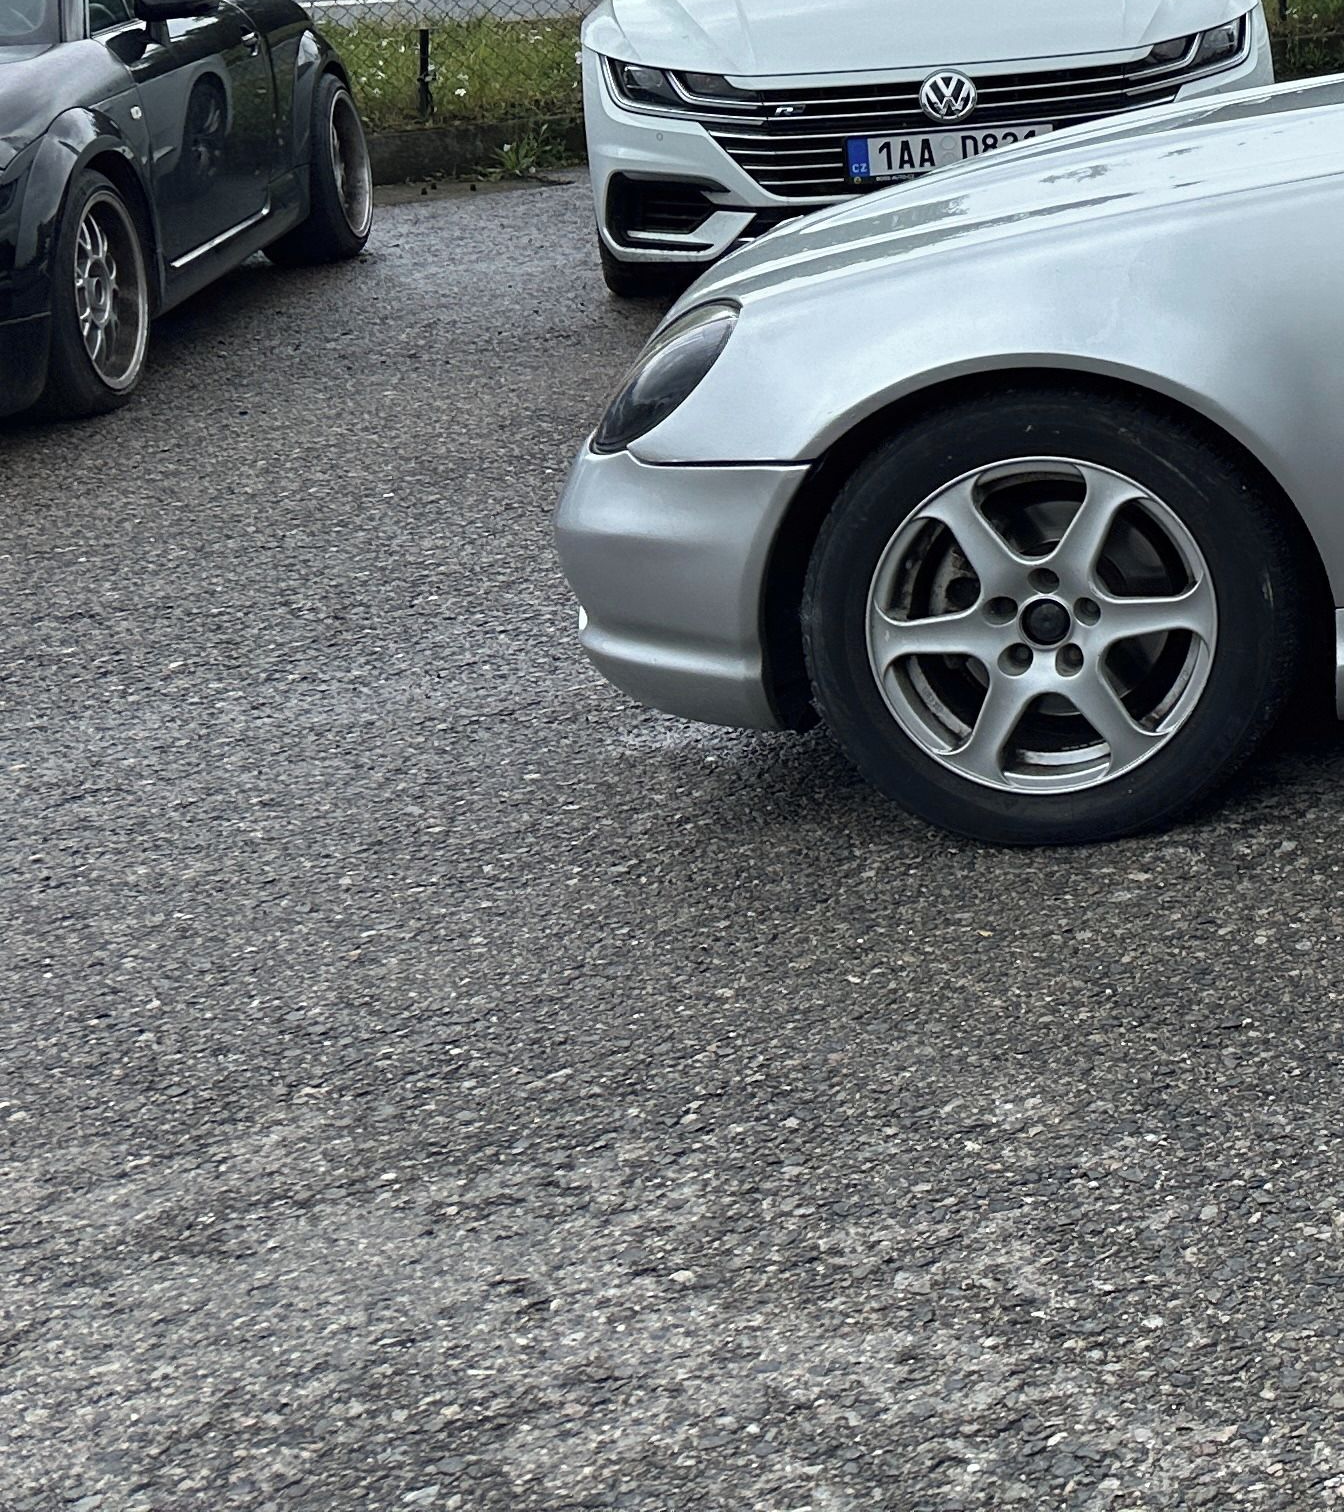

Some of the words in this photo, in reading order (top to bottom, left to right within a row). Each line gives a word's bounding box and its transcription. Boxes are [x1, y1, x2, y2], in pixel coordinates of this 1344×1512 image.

[878, 138, 936, 170] 1AA
[960, 129, 1037, 160] D8
[852, 163, 868, 173] CZ
